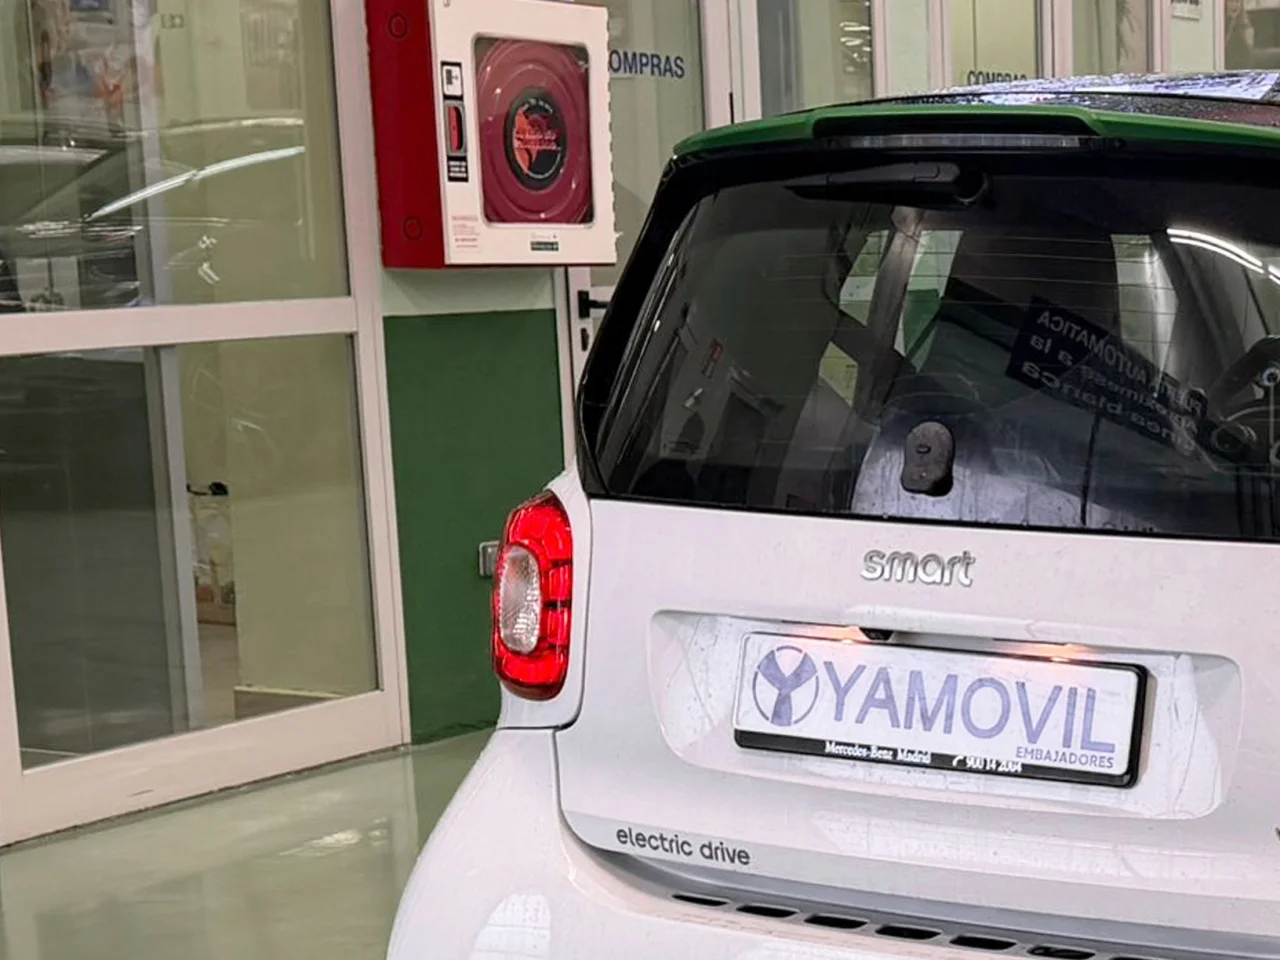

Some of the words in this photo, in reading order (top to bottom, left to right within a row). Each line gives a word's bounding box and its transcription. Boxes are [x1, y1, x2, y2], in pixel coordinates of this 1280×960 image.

[609, 49, 685, 79] OMPRAS
[860, 550, 976, 588] smart
[823, 661, 1116, 753] YAMOVIL
[825, 741, 893, 760] Mercedes-Benz
[897, 749, 931, 764] Madrid
[1015, 745, 1114, 769] EMBAJADORES
[616, 827, 694, 856] electric
[700, 841, 751, 865] drive
